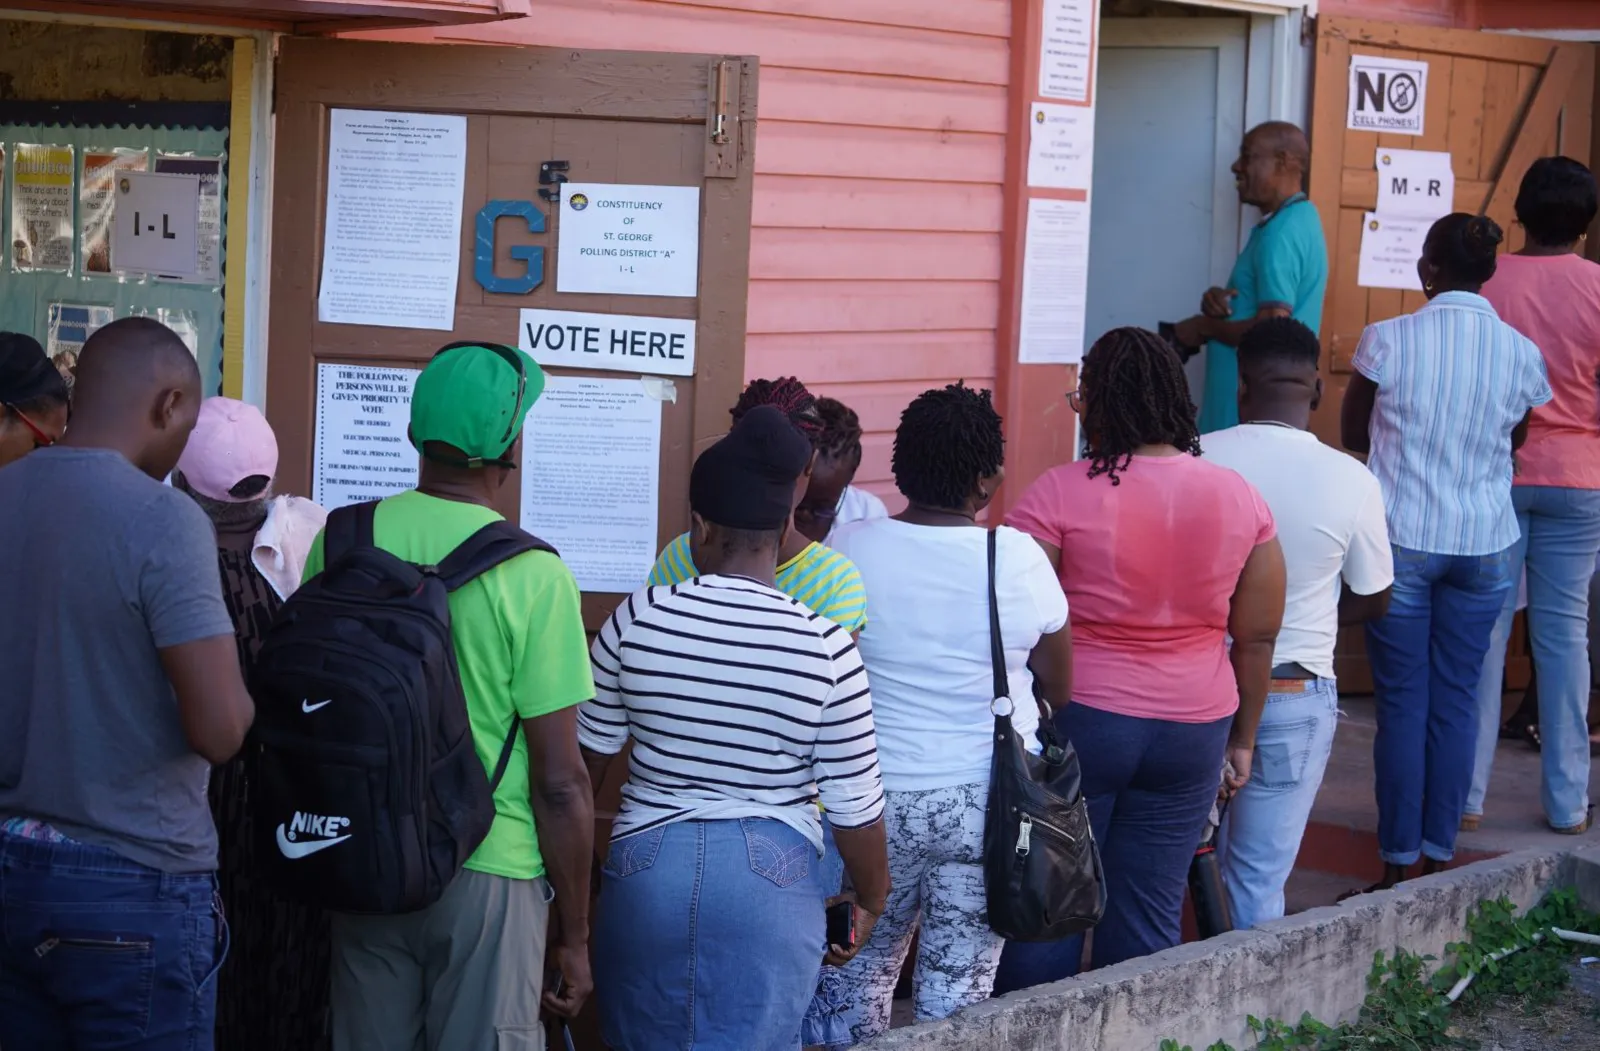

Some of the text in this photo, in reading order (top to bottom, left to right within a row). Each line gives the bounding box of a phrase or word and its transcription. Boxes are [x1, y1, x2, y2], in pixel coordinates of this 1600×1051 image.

[1357, 71, 1418, 114] NO
[1354, 116, 1376, 124] CELL
[1392, 178, 1408, 195] M
[1428, 180, 1441, 196] R
[597, 200, 662, 209] CONSTITUENCY
[134, 211, 140, 236] I
[163, 214, 176, 239] L
[617, 233, 653, 242] GEORGE
[475, 199, 546, 294] G
[580, 248, 617, 256] POLLING
[620, 249, 658, 258] DISTRICT
[526, 322, 686, 360] VOTE HERE
[357, 372, 408, 381] FOLLOWING
[336, 382, 373, 391] PERSONS
[374, 384, 396, 392] WILL
[361, 394, 398, 403] PRIORITY
[361, 405, 384, 414] VOTE
[290, 811, 341, 837] NIKE
